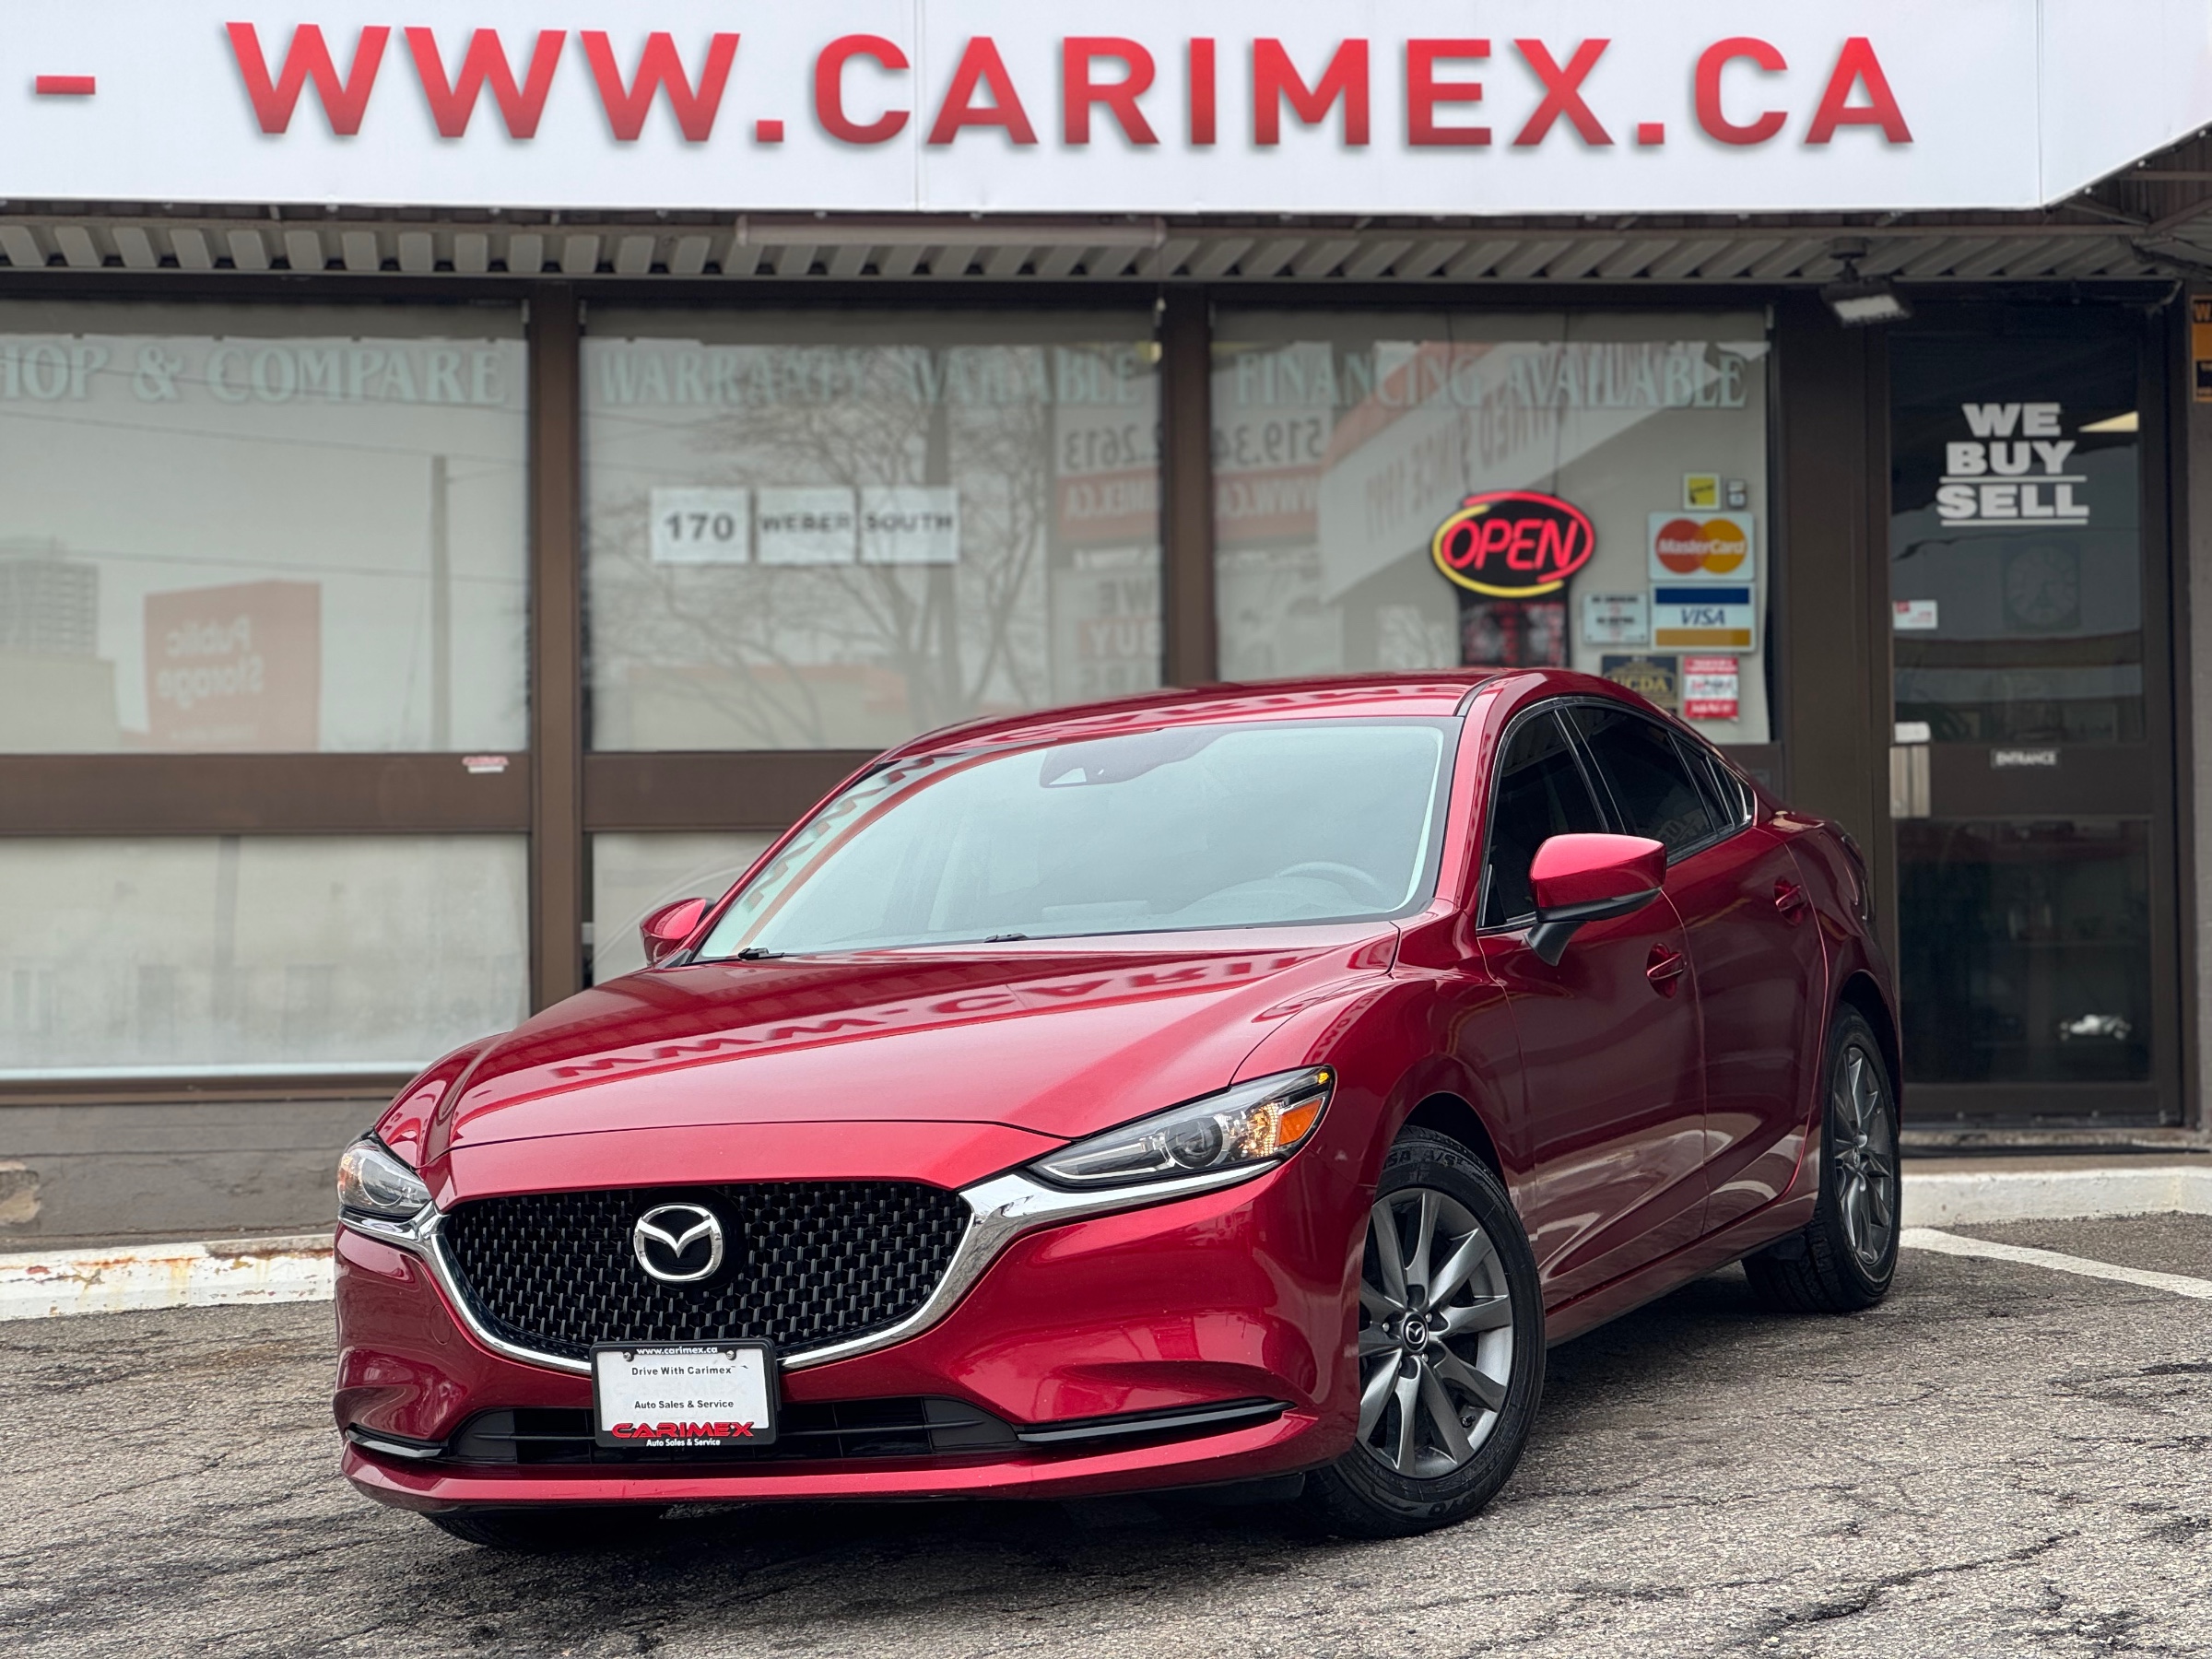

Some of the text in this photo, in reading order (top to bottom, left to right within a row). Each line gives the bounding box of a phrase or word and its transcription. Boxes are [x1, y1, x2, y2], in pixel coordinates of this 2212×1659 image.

[225, 22, 1914, 147] WWW.CARIMEX.CA
[134, 344, 182, 403] &
[204, 346, 510, 406] COMPARE
[1235, 350, 1749, 408] FINANCING AVAILABLE
[1961, 402, 2062, 438] WE
[1946, 441, 2077, 476] BUY
[1936, 484, 2090, 519] SELL
[665, 510, 954, 543] 170 WEBER SOUTH
[1441, 517, 1581, 571] OPEN
[1657, 536, 1747, 555] MasterCard
[1680, 607, 1726, 626] VISA
[636, 1346, 719, 1356] www.carimex.ca
[631, 1365, 732, 1376] Drive With Carimex
[634, 1399, 735, 1409] Auto Sales & Service
[611, 1421, 755, 1439] CARIMEX
[646, 1438, 721, 1447] Auto Sales & Service
